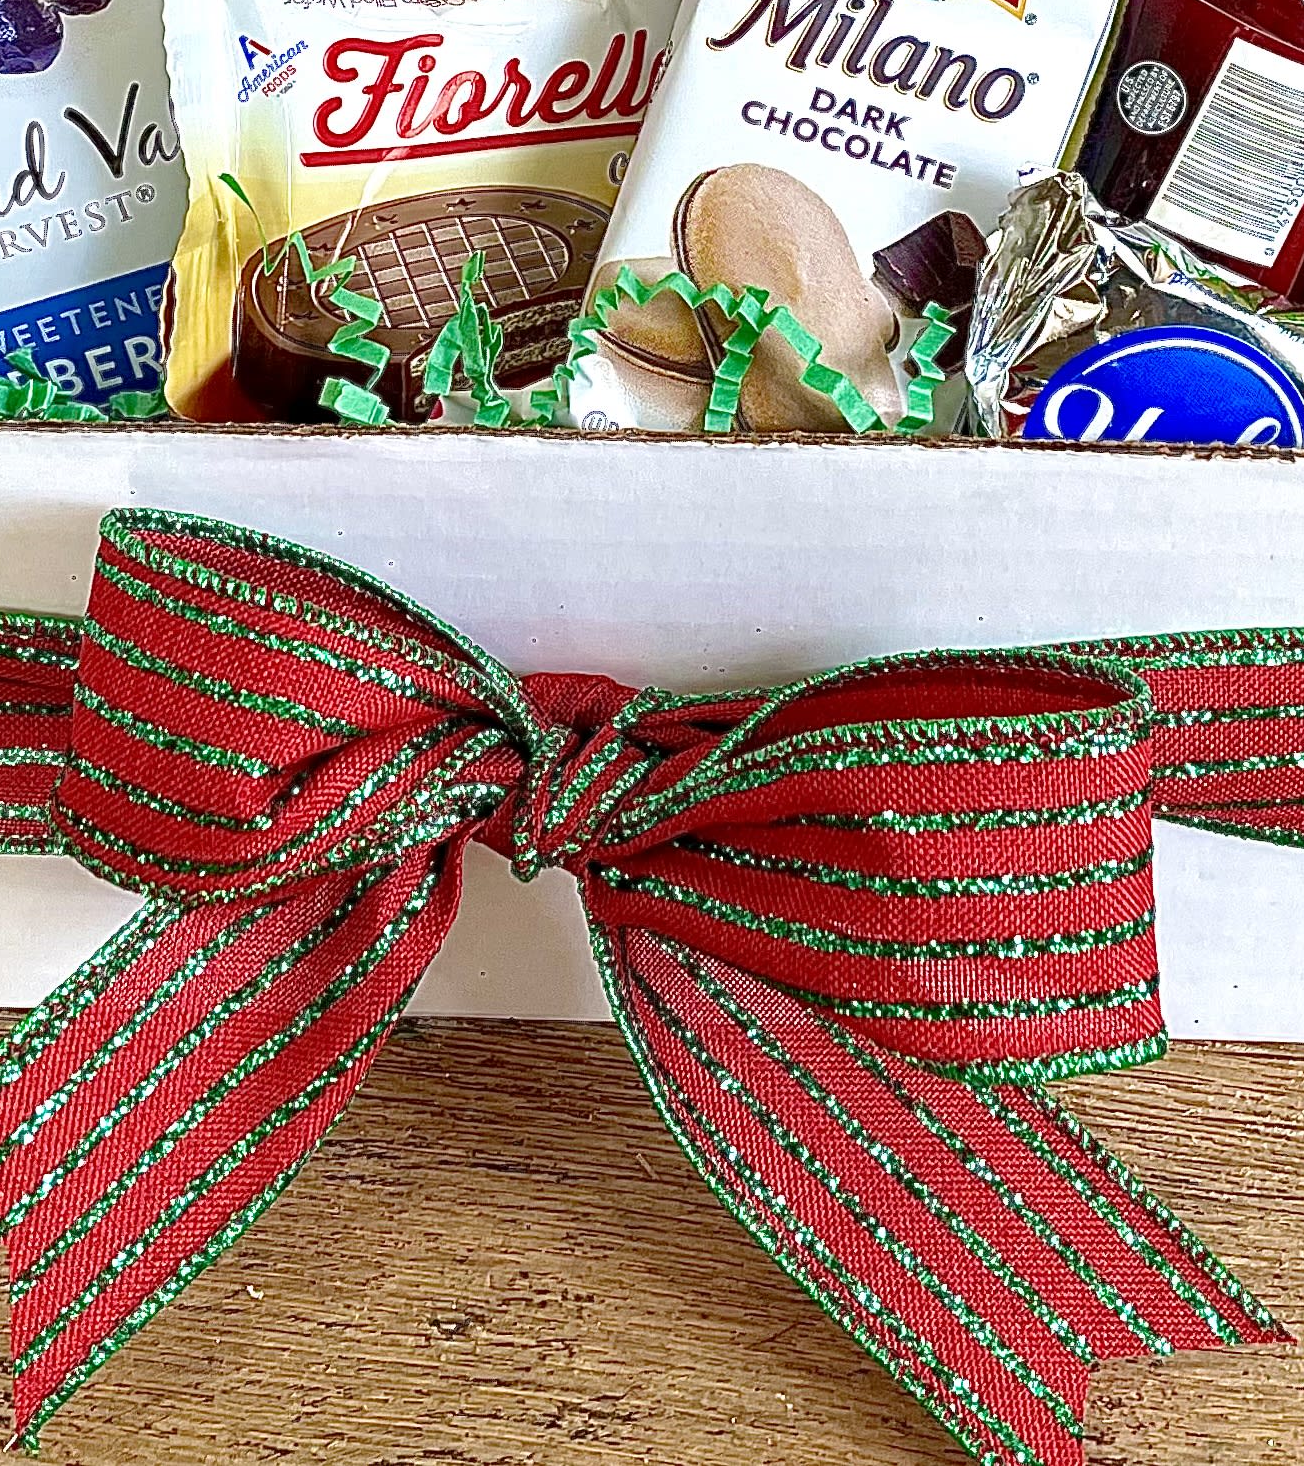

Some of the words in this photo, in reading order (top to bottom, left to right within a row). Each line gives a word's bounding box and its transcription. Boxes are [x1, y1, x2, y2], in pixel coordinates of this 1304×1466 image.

[238, 40, 309, 102] American
[262, 64, 297, 97] FOODS
[1120, 73, 1136, 93] U.S.
[63, 82, 181, 180] Va
[809, 87, 912, 141] DARK
[741, 100, 958, 190] CHOCOLATE
